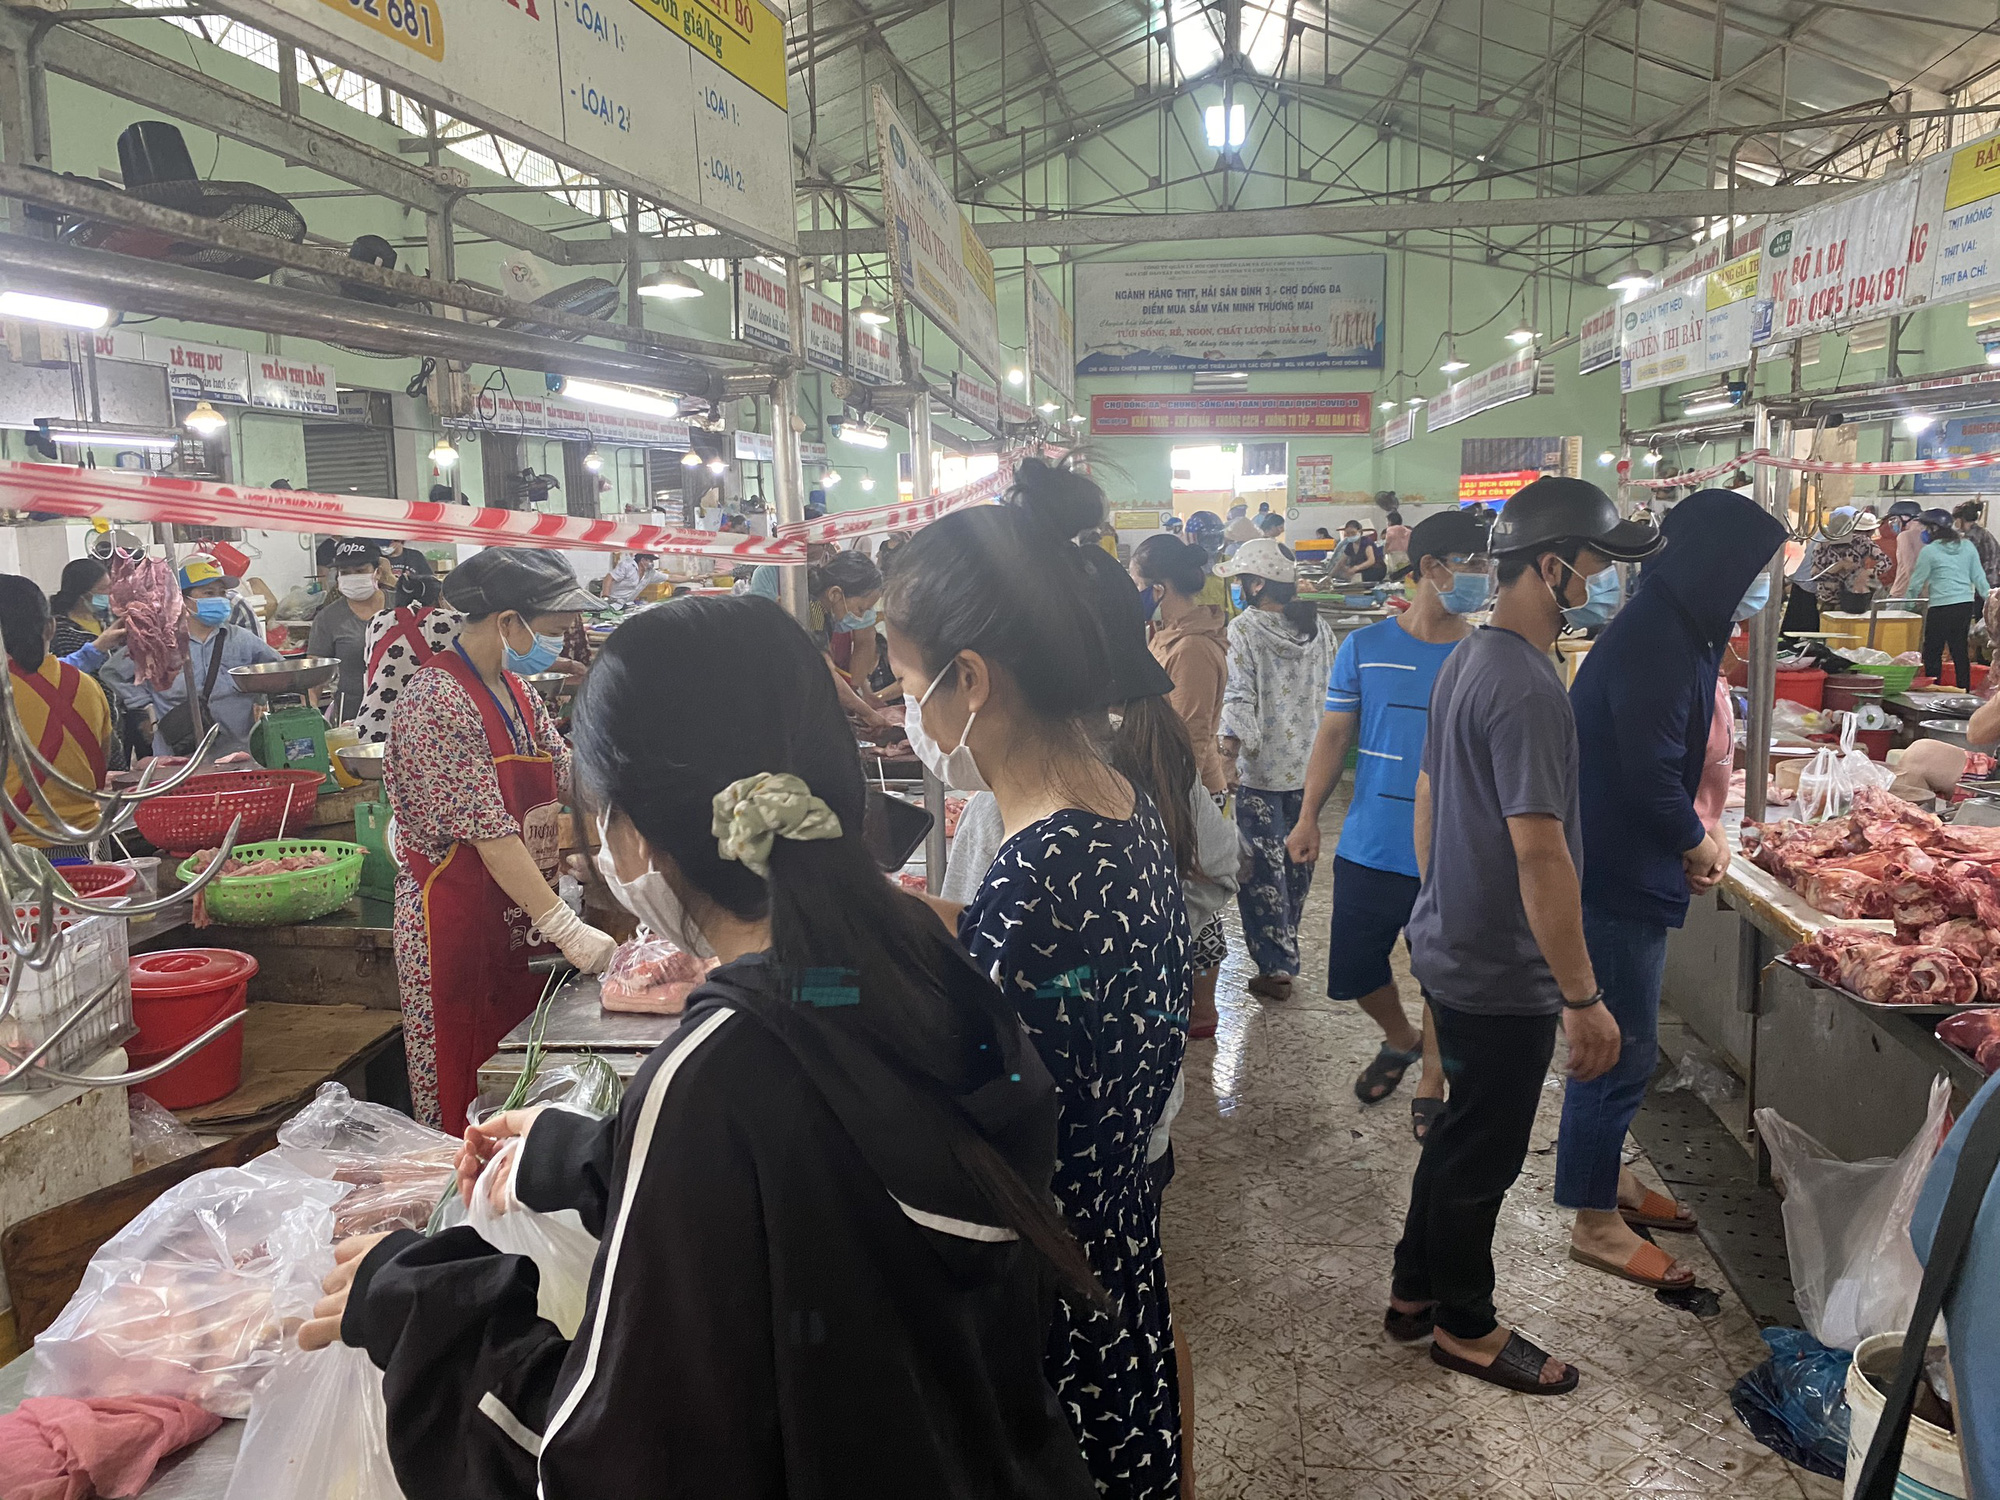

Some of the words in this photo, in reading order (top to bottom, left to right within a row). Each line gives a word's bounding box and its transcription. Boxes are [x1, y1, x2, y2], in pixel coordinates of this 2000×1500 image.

[387, 0, 431, 44] 681
[575, 0, 608, 42] LOẠI
[683, 8, 723, 59] giá/kg
[581, 83, 614, 126] LOẠI
[705, 86, 728, 120] LOẠI
[710, 156, 735, 189] LOẠI
[1957, 269, 1969, 281] BA
[1115, 289, 1145, 300] NGÀNH
[1176, 288, 1198, 301] THỊT,
[1265, 287, 1270, 296] 3
[1329, 284, 1341, 293] ĐA
[1167, 305, 1186, 314] MUA
[1212, 300, 1230, 312] VĂN
[1232, 302, 1255, 312] MINH
[1258, 301, 1293, 311] THƯƠNG
[1187, 328, 1215, 337] NGON,
[186, 351, 206, 374] THỊ
[1320, 399, 1345, 407] COVID
[1499, 479, 1522, 488] COVID
